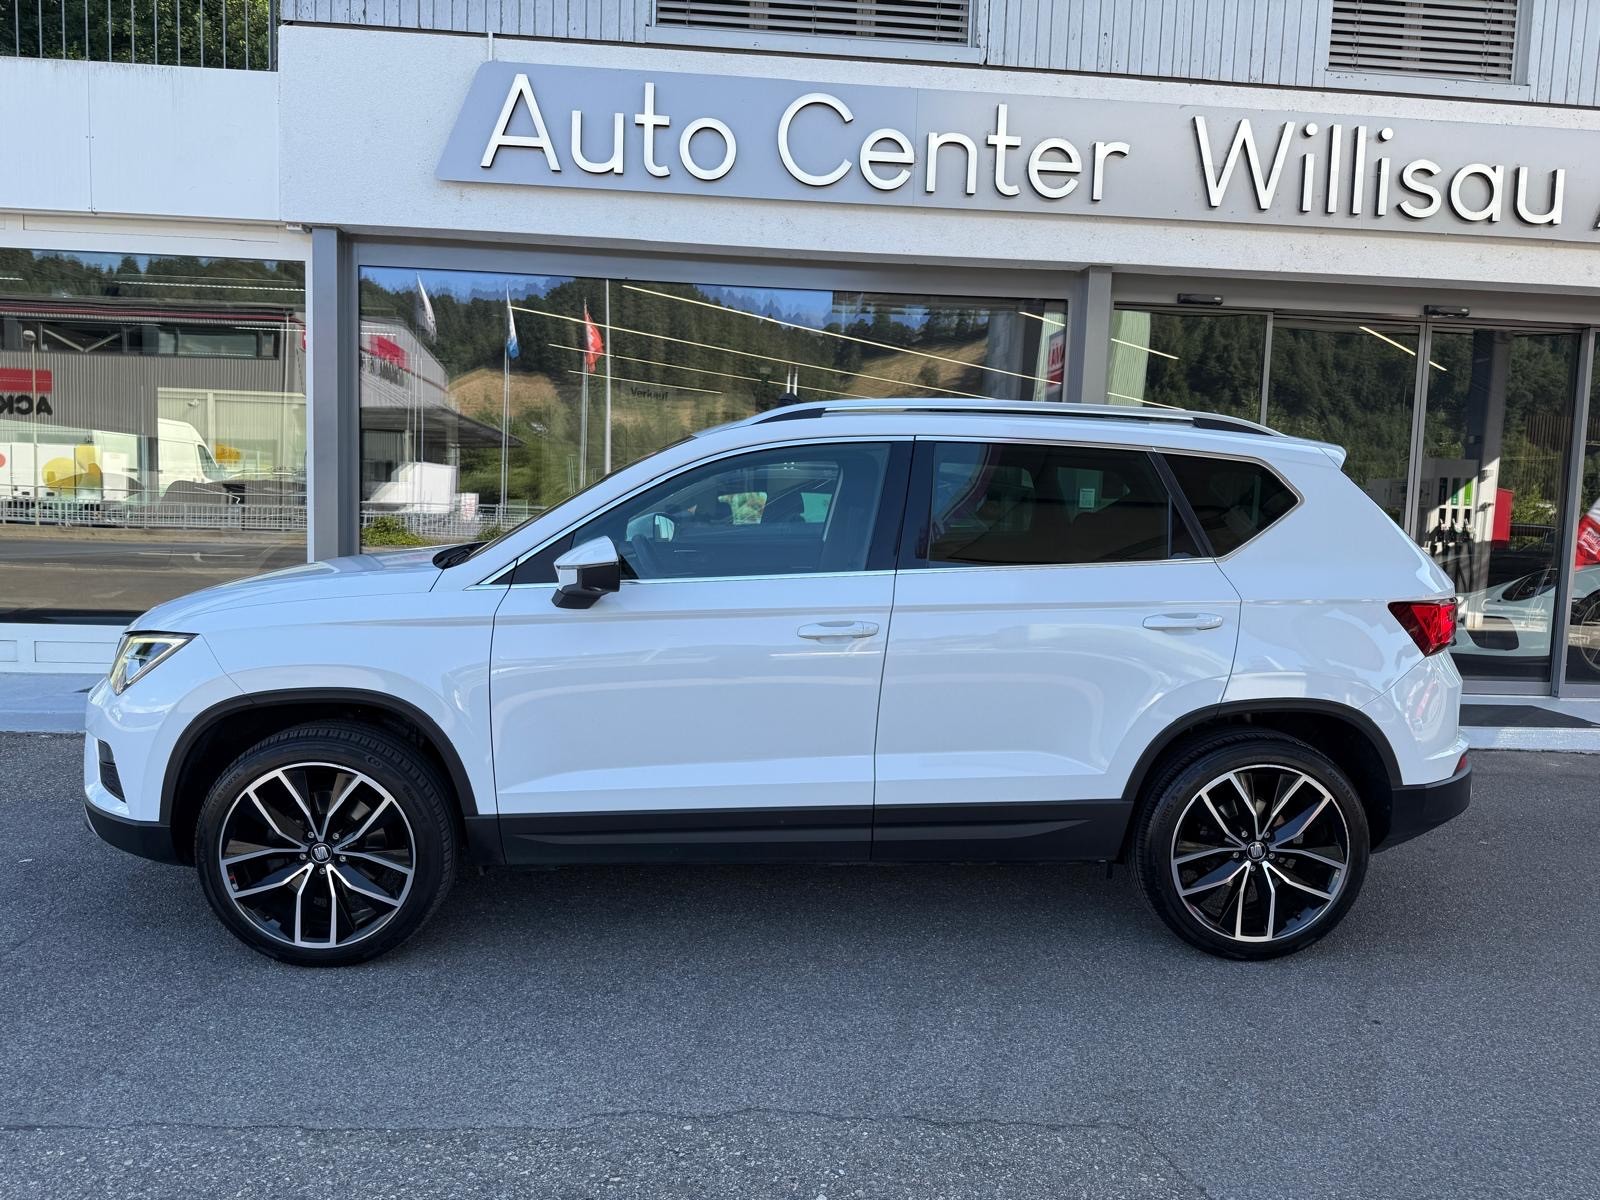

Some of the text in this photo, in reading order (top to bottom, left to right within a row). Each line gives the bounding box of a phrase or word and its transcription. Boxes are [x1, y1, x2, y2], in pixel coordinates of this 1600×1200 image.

[480, 73, 1565, 225] Auto Center Willisau
